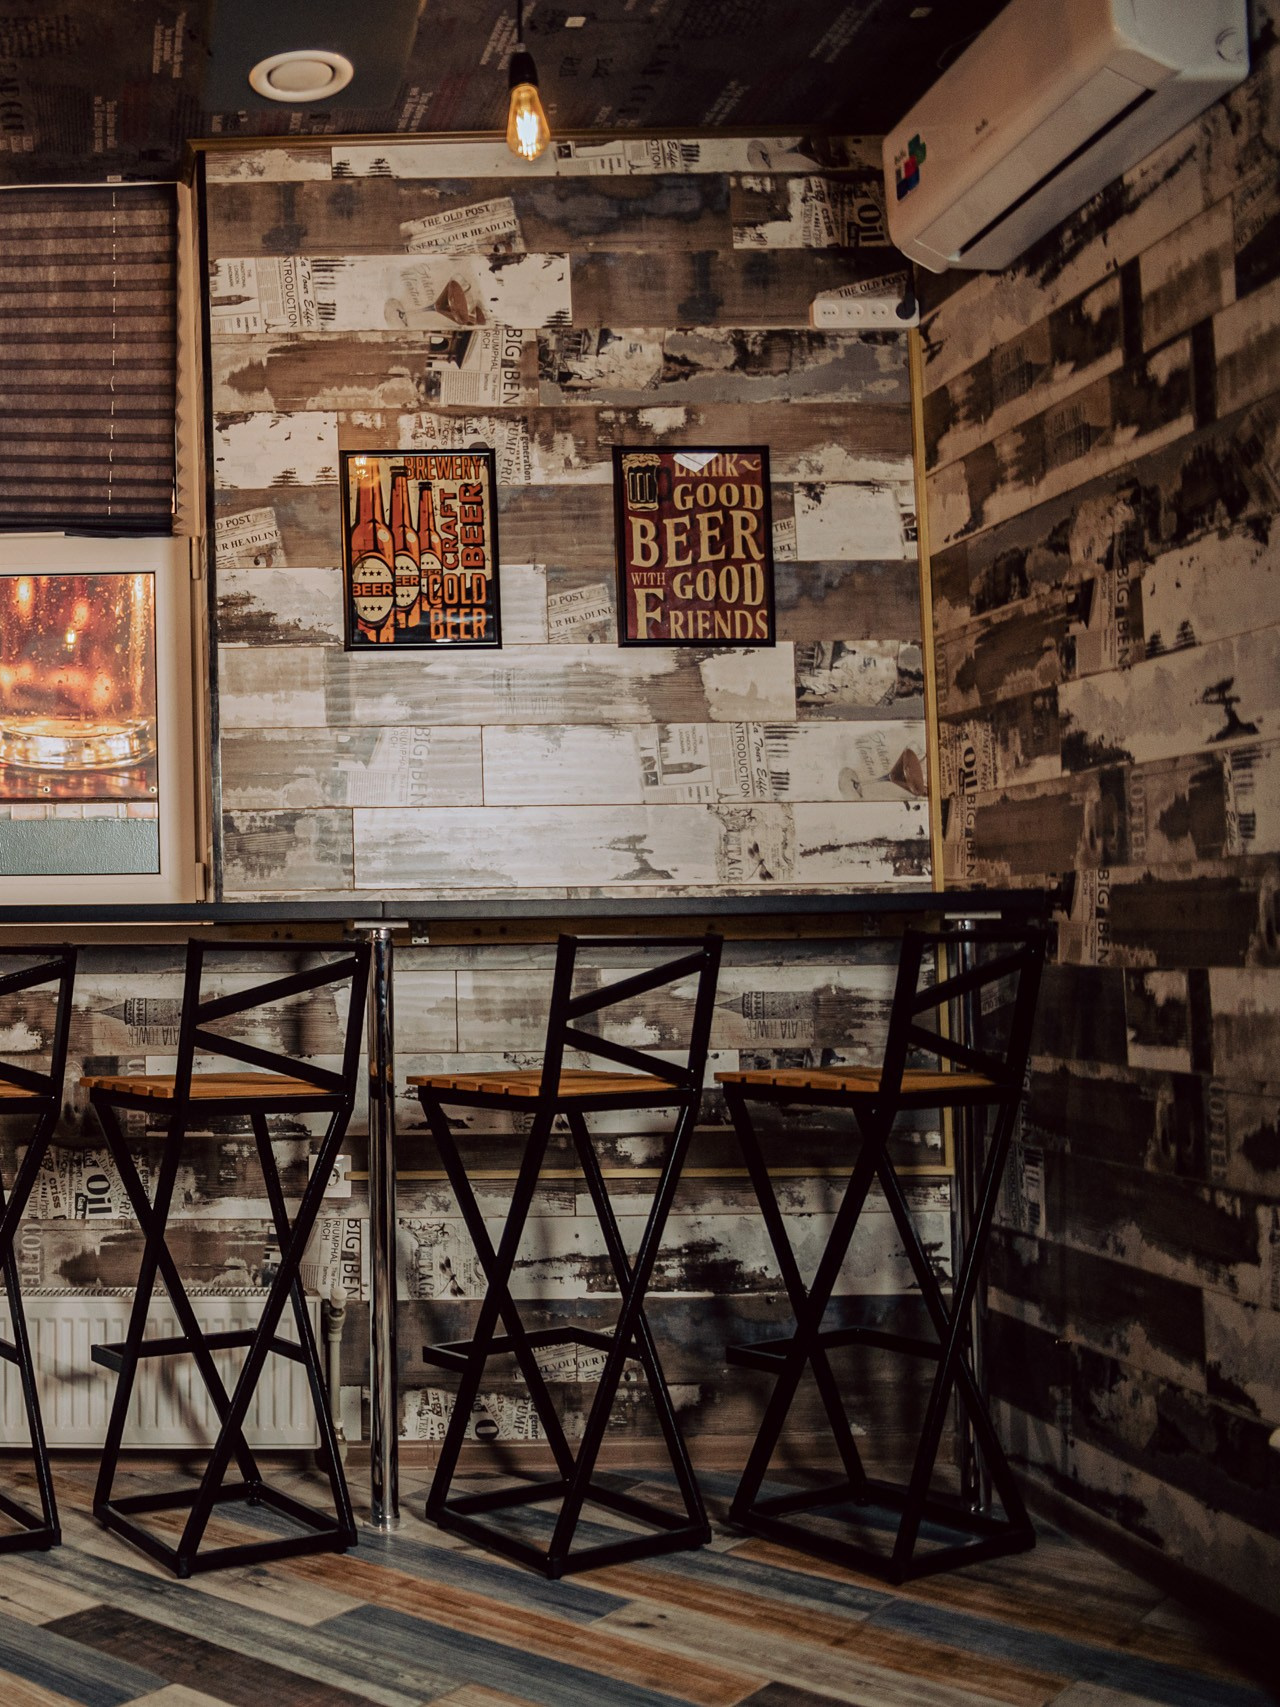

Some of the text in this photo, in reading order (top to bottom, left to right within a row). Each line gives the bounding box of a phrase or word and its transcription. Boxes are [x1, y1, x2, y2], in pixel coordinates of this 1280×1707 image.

[421, 204, 490, 228] THE OLD POST
[503, 329, 522, 405] BIG BEN
[404, 456, 481, 480] BREWERY
[673, 483, 764, 511] GOOD
[225, 514, 251, 528] POST
[440, 488, 459, 570] CRAFT
[459, 482, 485, 569] BEER
[773, 521, 793, 532] THE
[628, 510, 765, 568] BEER
[352, 583, 393, 596] BEER
[395, 575, 420, 587] EER
[428, 573, 487, 605] COLD
[631, 572, 666, 586] WITH
[673, 563, 764, 606] GOOD
[559, 591, 584, 605] POST
[634, 588, 768, 640] FRIENDS
[430, 607, 487, 640] BEER
[413, 727, 431, 756] BIG
[1097, 922, 1110, 964] BEN
[49, 1177, 61, 1209] criss
[86, 1174, 112, 1214] Oil
[342, 1219, 361, 1300] BIG BEN
